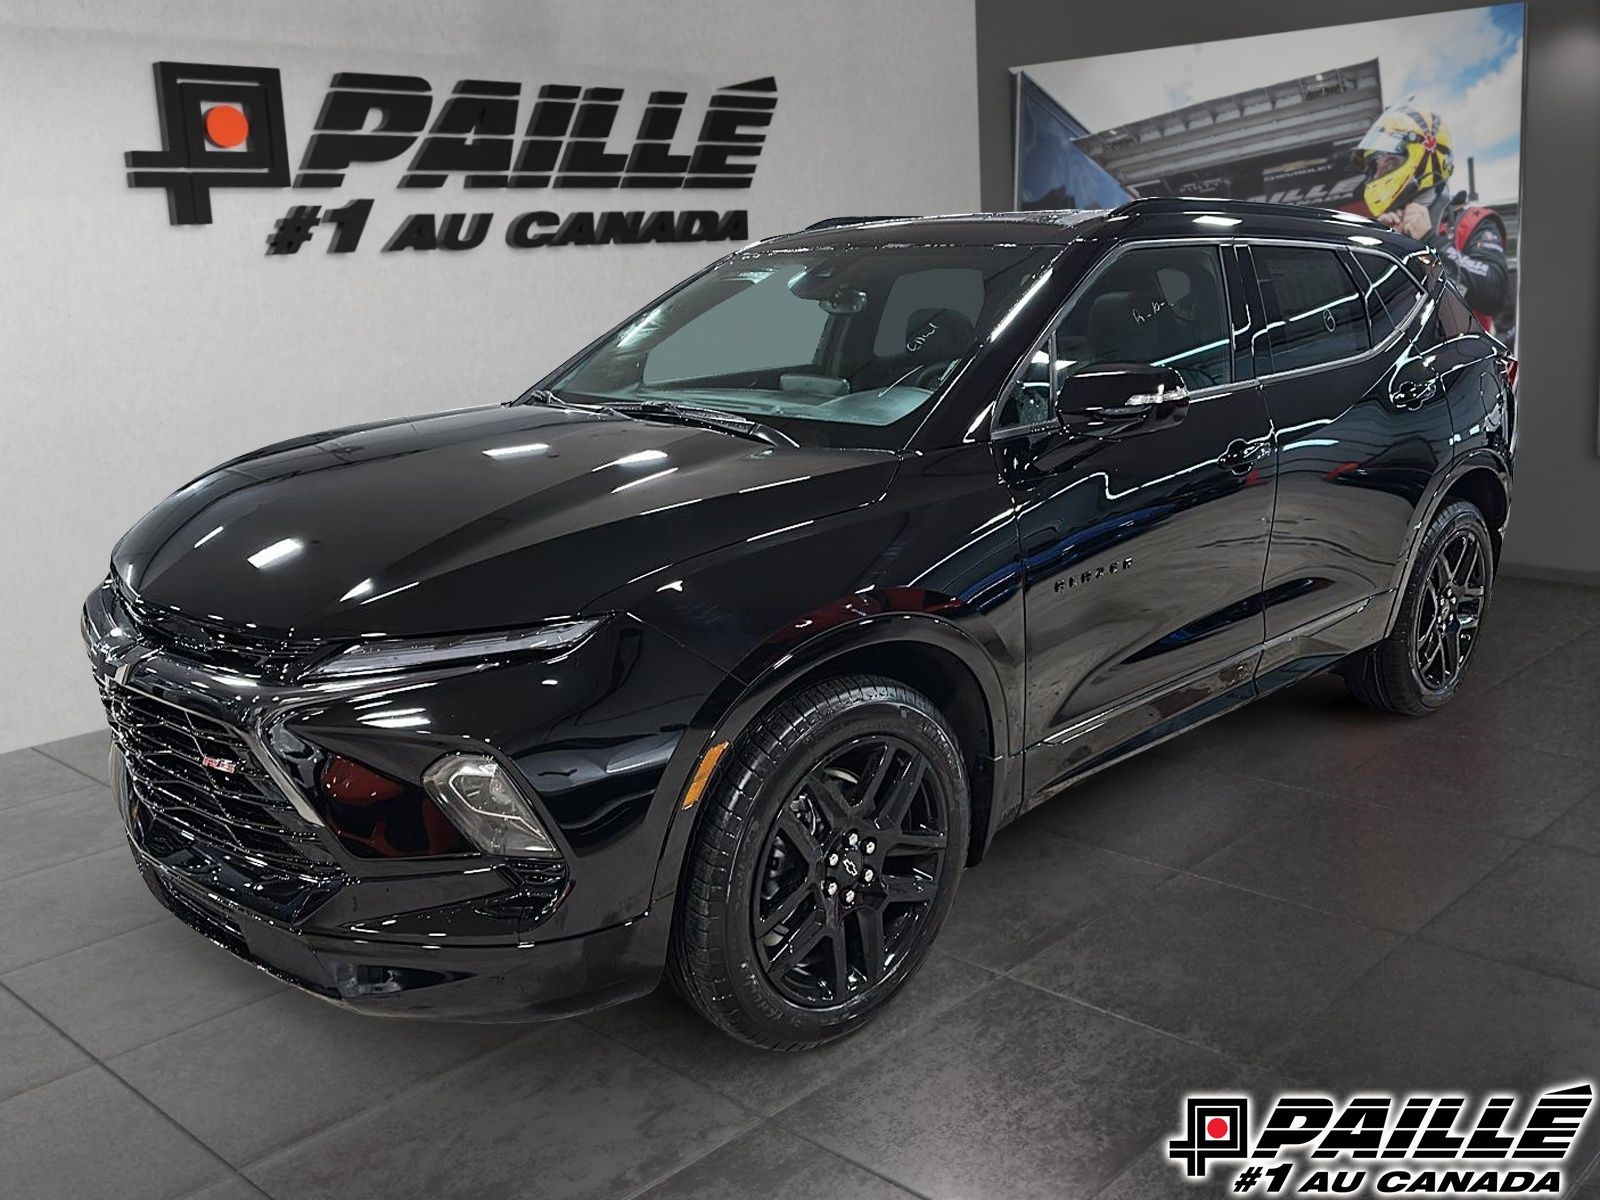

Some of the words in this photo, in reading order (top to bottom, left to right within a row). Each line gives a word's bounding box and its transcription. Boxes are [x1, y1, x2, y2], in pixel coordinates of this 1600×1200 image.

[292, 72, 778, 188] PAILLÉ
[1263, 165, 1333, 182] CHEVROLET
[265, 199, 375, 256] #1
[381, 213, 493, 252] AU
[505, 210, 748, 249] CANADA
